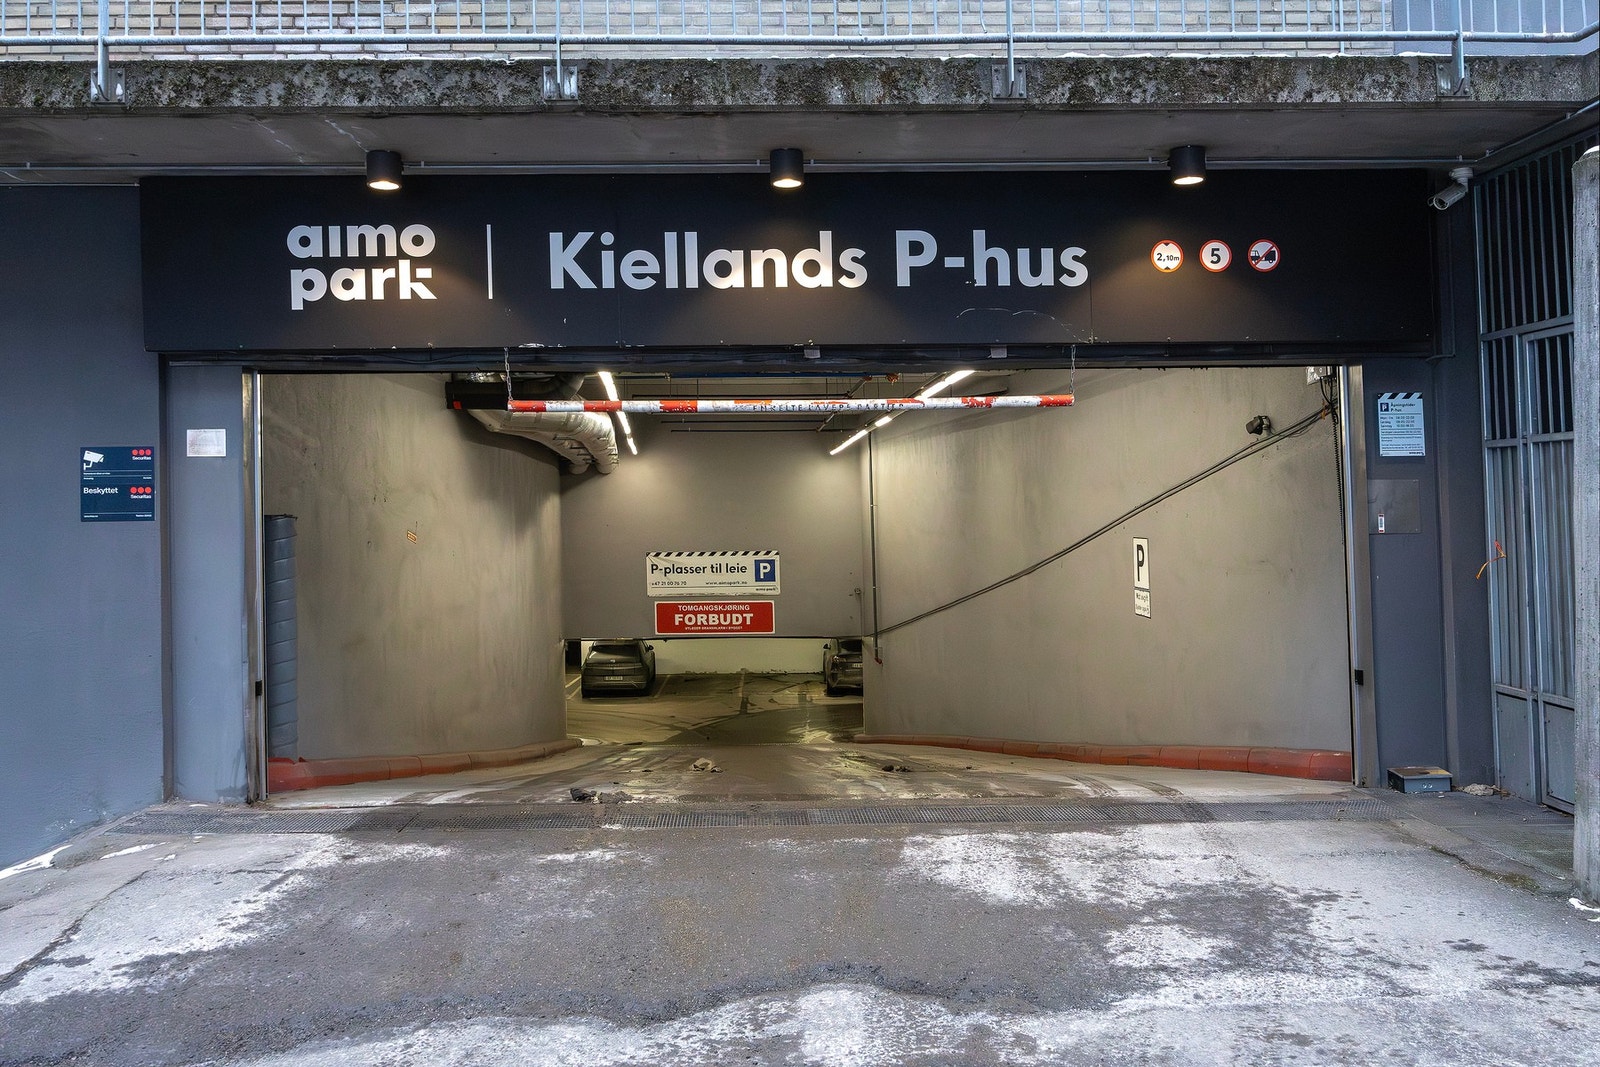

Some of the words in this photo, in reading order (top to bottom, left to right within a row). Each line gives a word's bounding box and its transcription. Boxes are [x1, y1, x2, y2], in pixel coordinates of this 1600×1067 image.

[287, 224, 436, 258] aimo
[549, 231, 867, 290] Kiellands
[895, 229, 1088, 288] P-hus
[1156, 252, 1180, 262] 2,10m
[1210, 247, 1222, 264] 5
[290, 259, 437, 310] park
[83, 487, 119, 495] Beskyttet
[651, 563, 707, 577] P-plasser
[710, 563, 722, 574] til
[725, 562, 748, 574] leie
[759, 562, 771, 579] P
[1136, 544, 1145, 582] P
[678, 604, 750, 612] TOMGANGSKJØRING
[674, 613, 754, 625] FORBUDT
